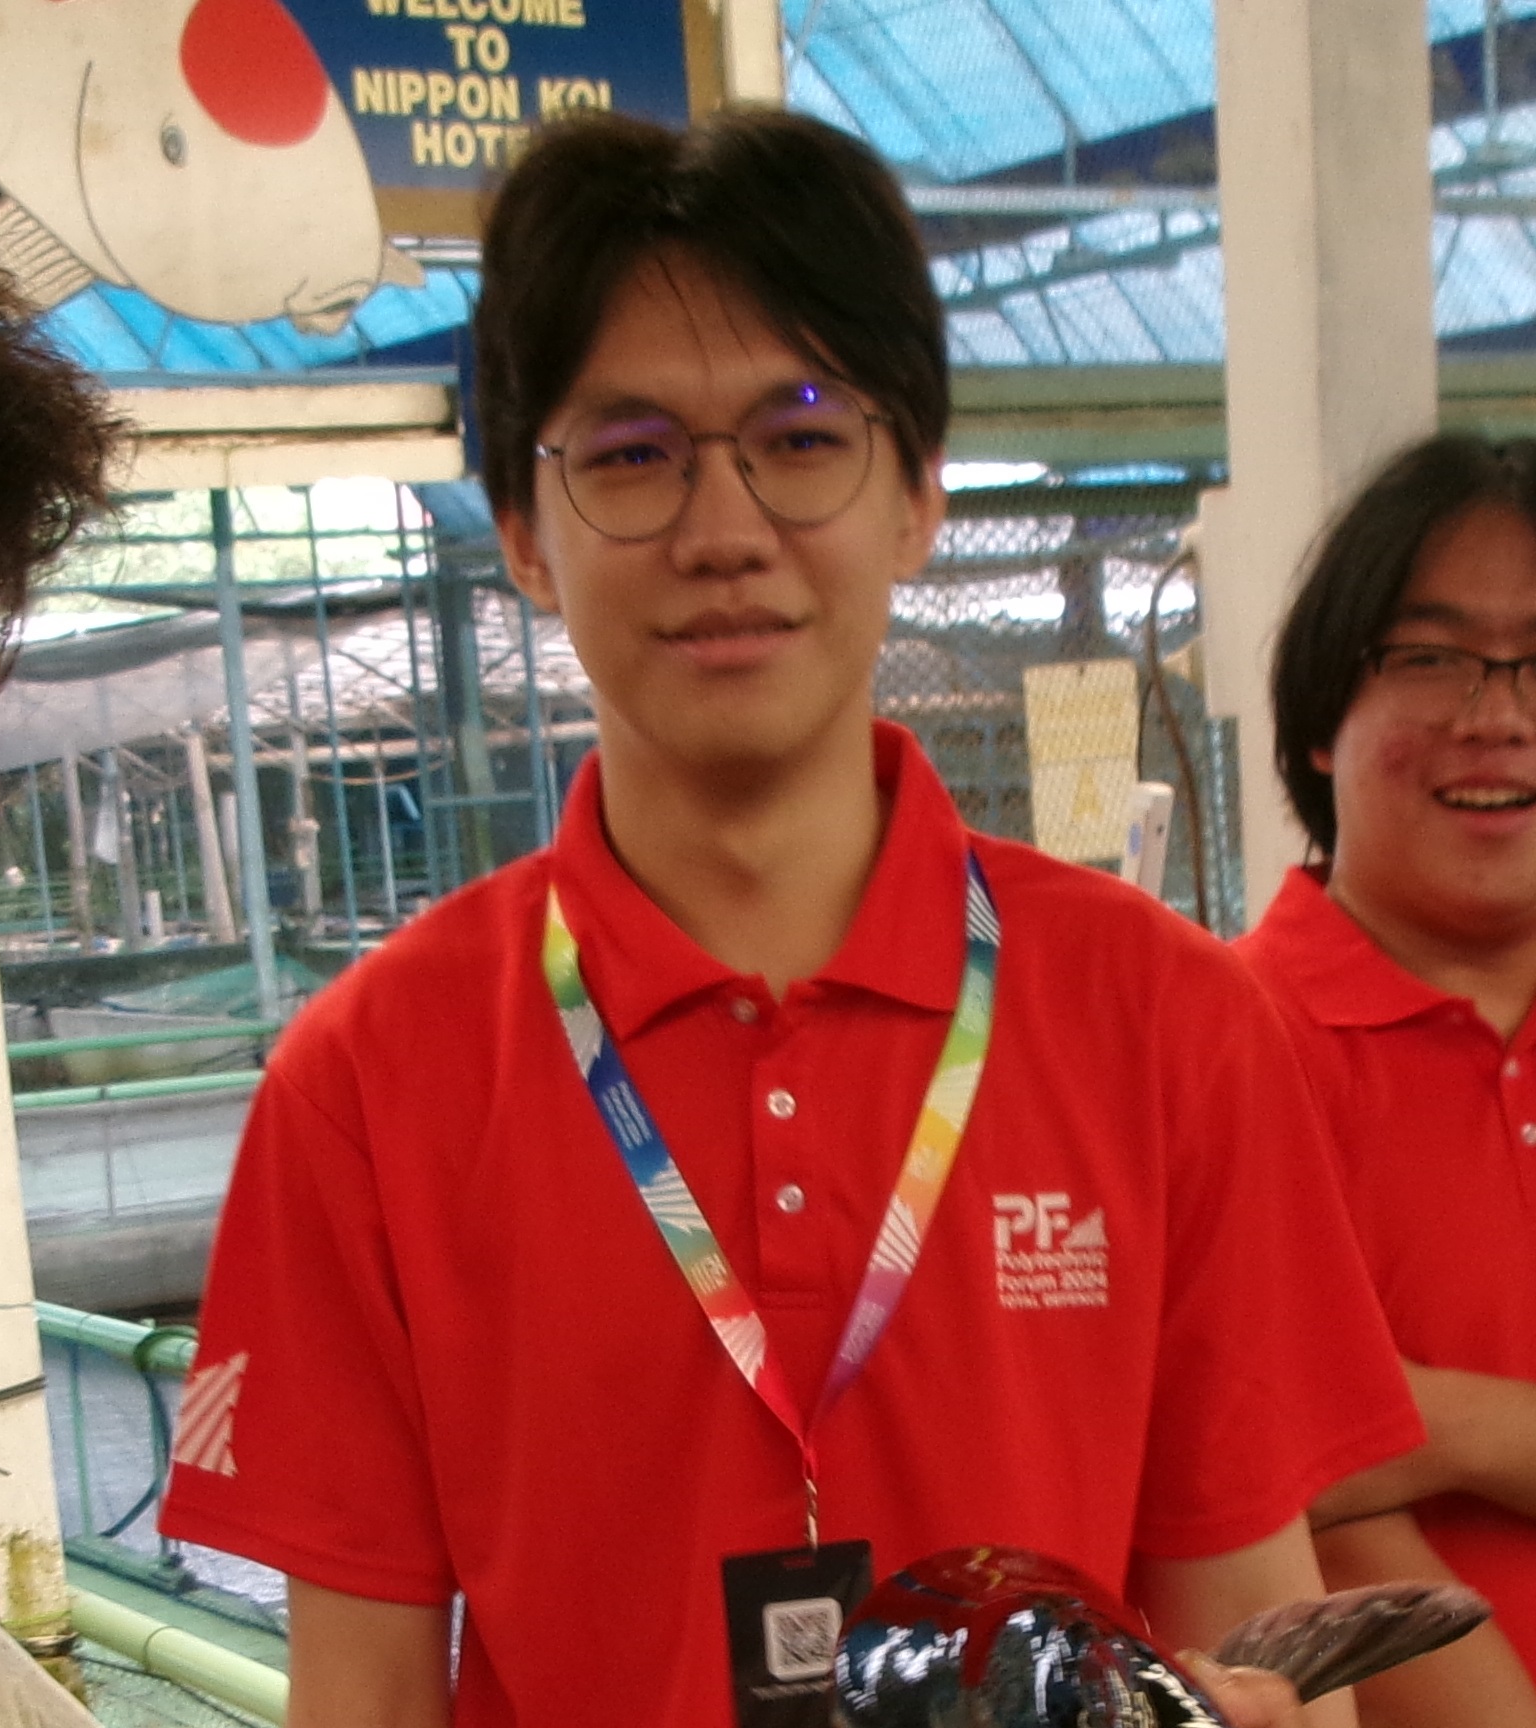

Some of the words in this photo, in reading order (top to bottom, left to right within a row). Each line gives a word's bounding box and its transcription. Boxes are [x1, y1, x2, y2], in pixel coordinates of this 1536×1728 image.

[446, 24, 510, 72] TO
[353, 68, 521, 121] NIPPON
[539, 77, 613, 119] KOI
[411, 121, 531, 168] HOTE
